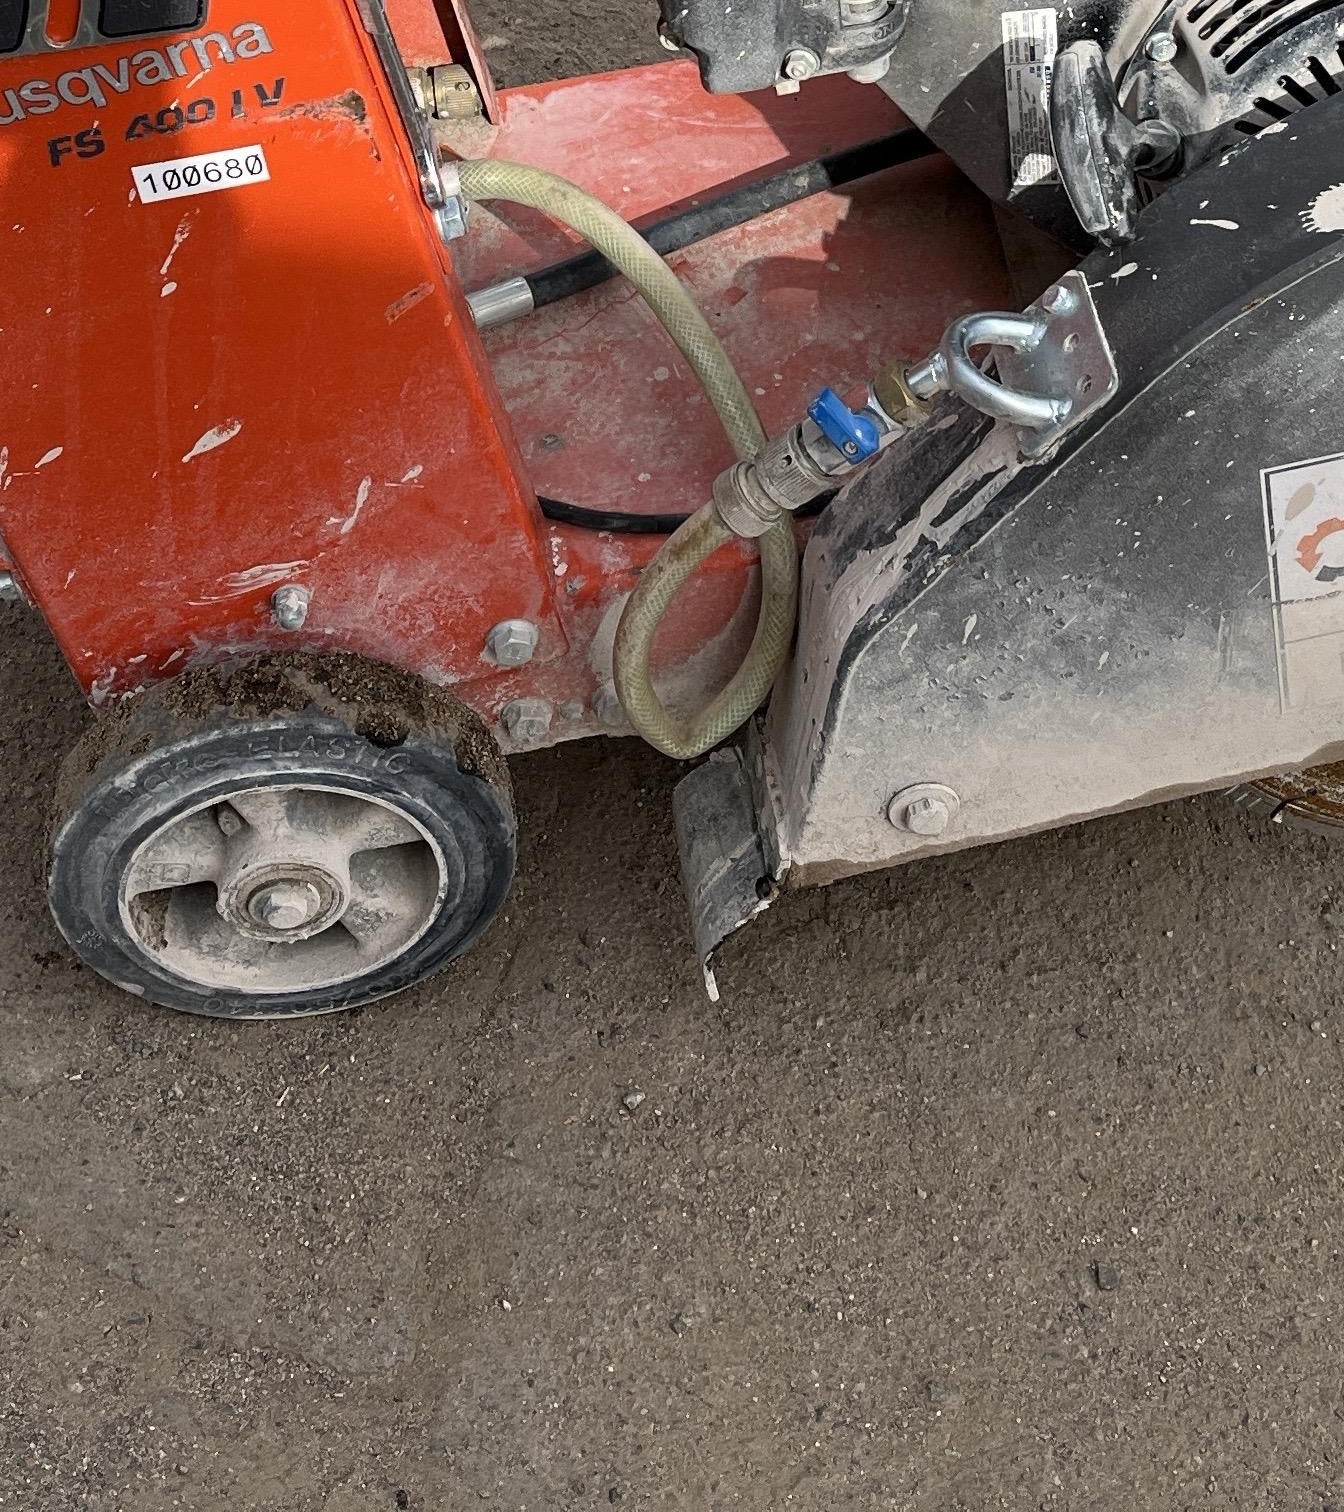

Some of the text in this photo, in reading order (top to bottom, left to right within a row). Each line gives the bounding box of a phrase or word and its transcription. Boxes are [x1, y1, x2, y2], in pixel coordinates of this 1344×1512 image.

[47, 128, 106, 167] FS
[125, 97, 217, 142] 400
[143, 153, 264, 194] 100680
